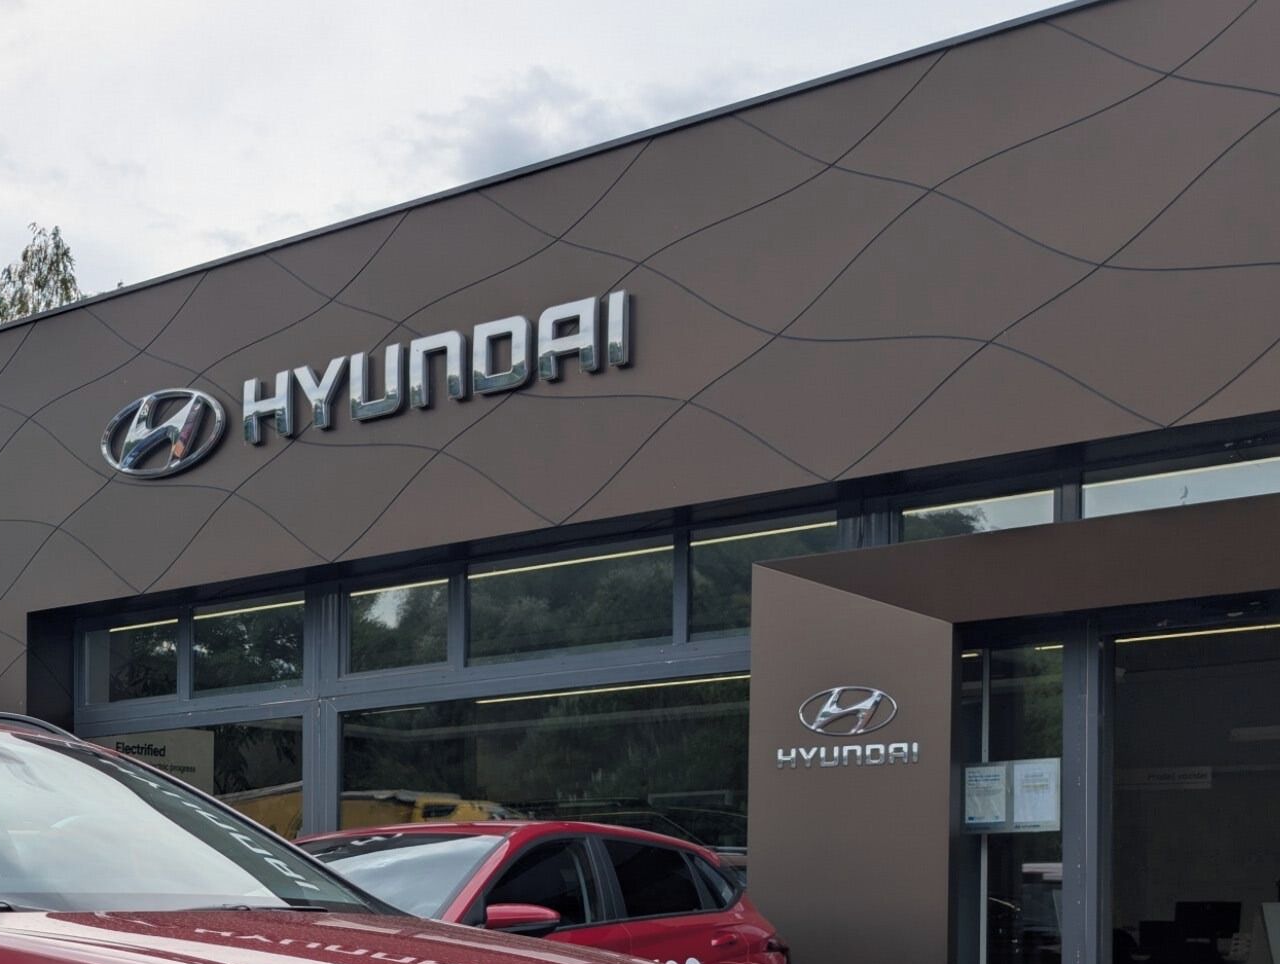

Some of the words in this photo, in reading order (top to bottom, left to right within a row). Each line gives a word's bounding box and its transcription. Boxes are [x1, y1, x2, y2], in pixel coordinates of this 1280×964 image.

[242, 289, 631, 446] HYUNDAI
[115, 742, 166, 757] Electrified
[776, 742, 919, 769] HYUNDAI
